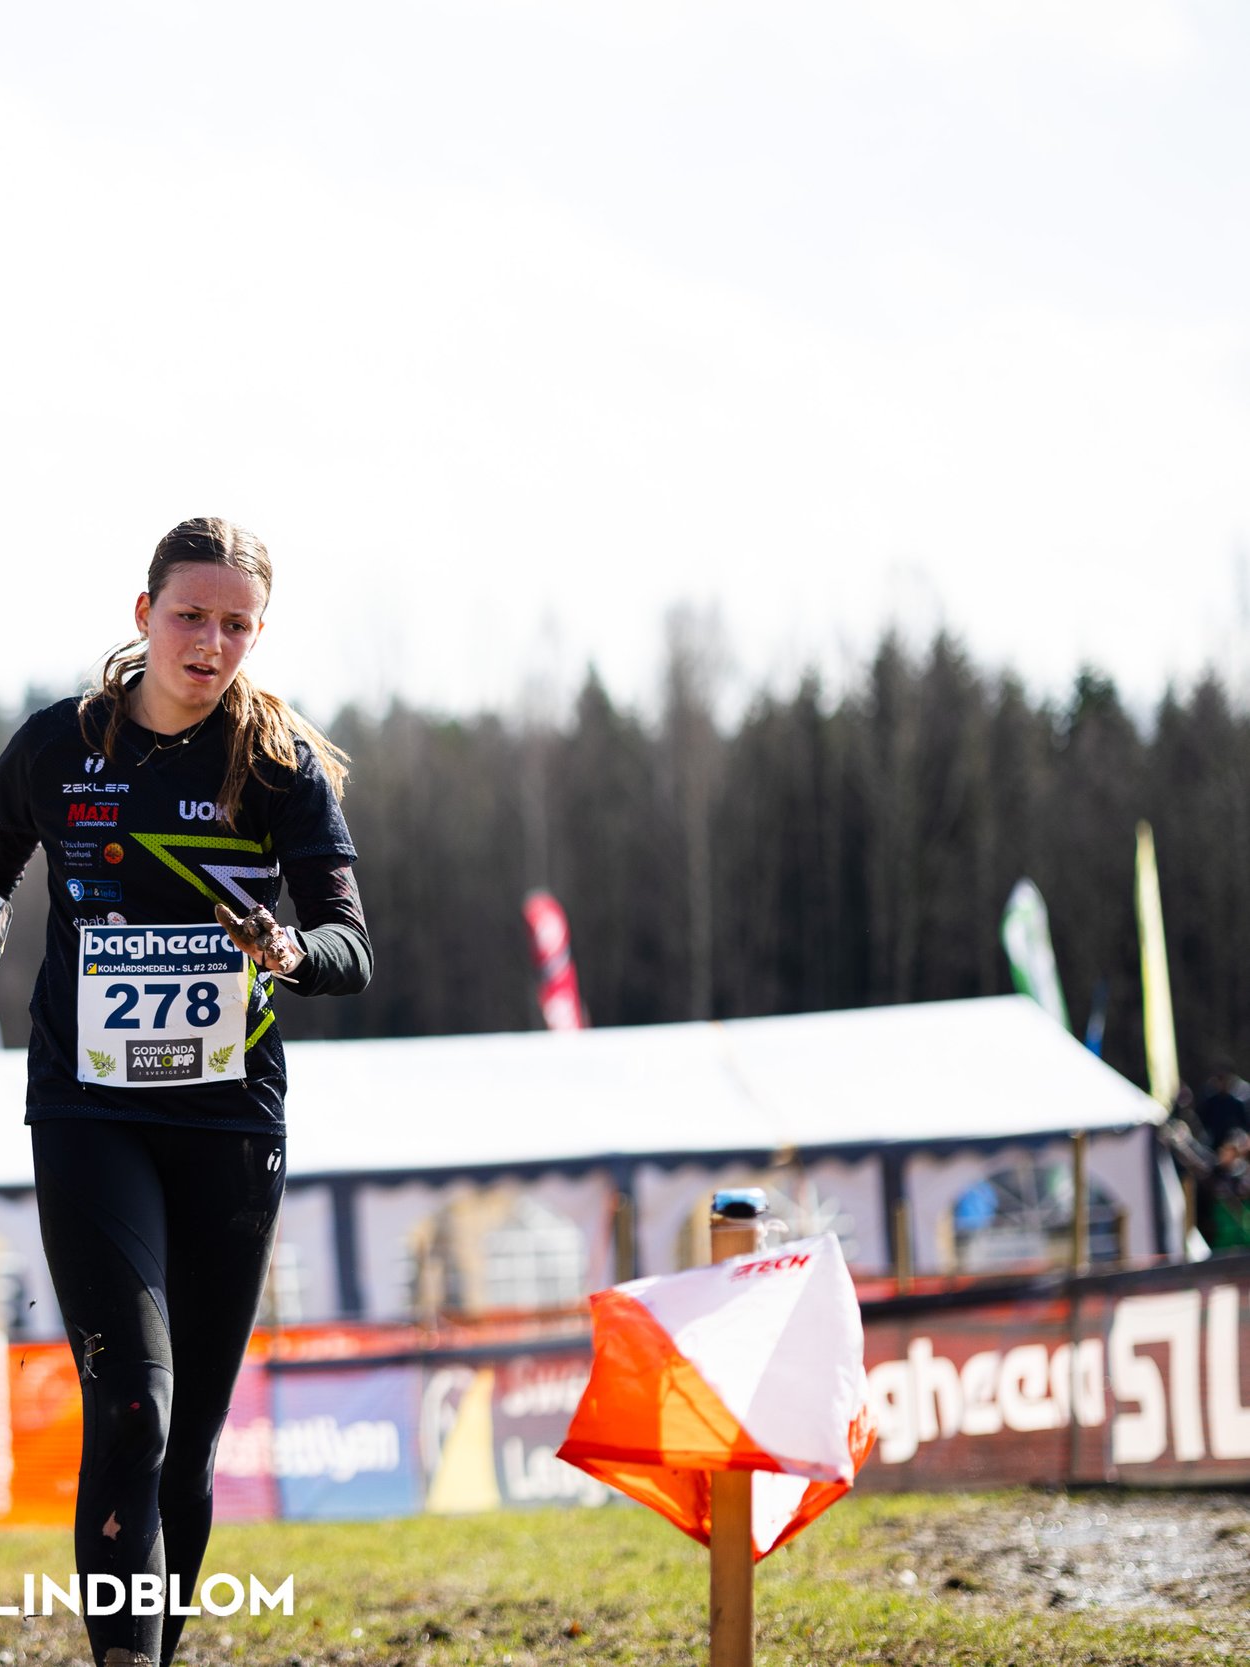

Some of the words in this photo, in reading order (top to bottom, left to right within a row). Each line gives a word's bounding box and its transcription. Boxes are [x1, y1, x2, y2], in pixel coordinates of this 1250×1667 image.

[62, 783, 130, 793] ZEKLER
[68, 803, 119, 821] MAXI
[98, 963, 175, 973] KOLMÅRDSMEDELN
[207, 963, 228, 972] 2026
[104, 981, 221, 1029] 278
[132, 1043, 196, 1056] GODKÄNDA
[865, 1336, 1107, 1465] gheera
